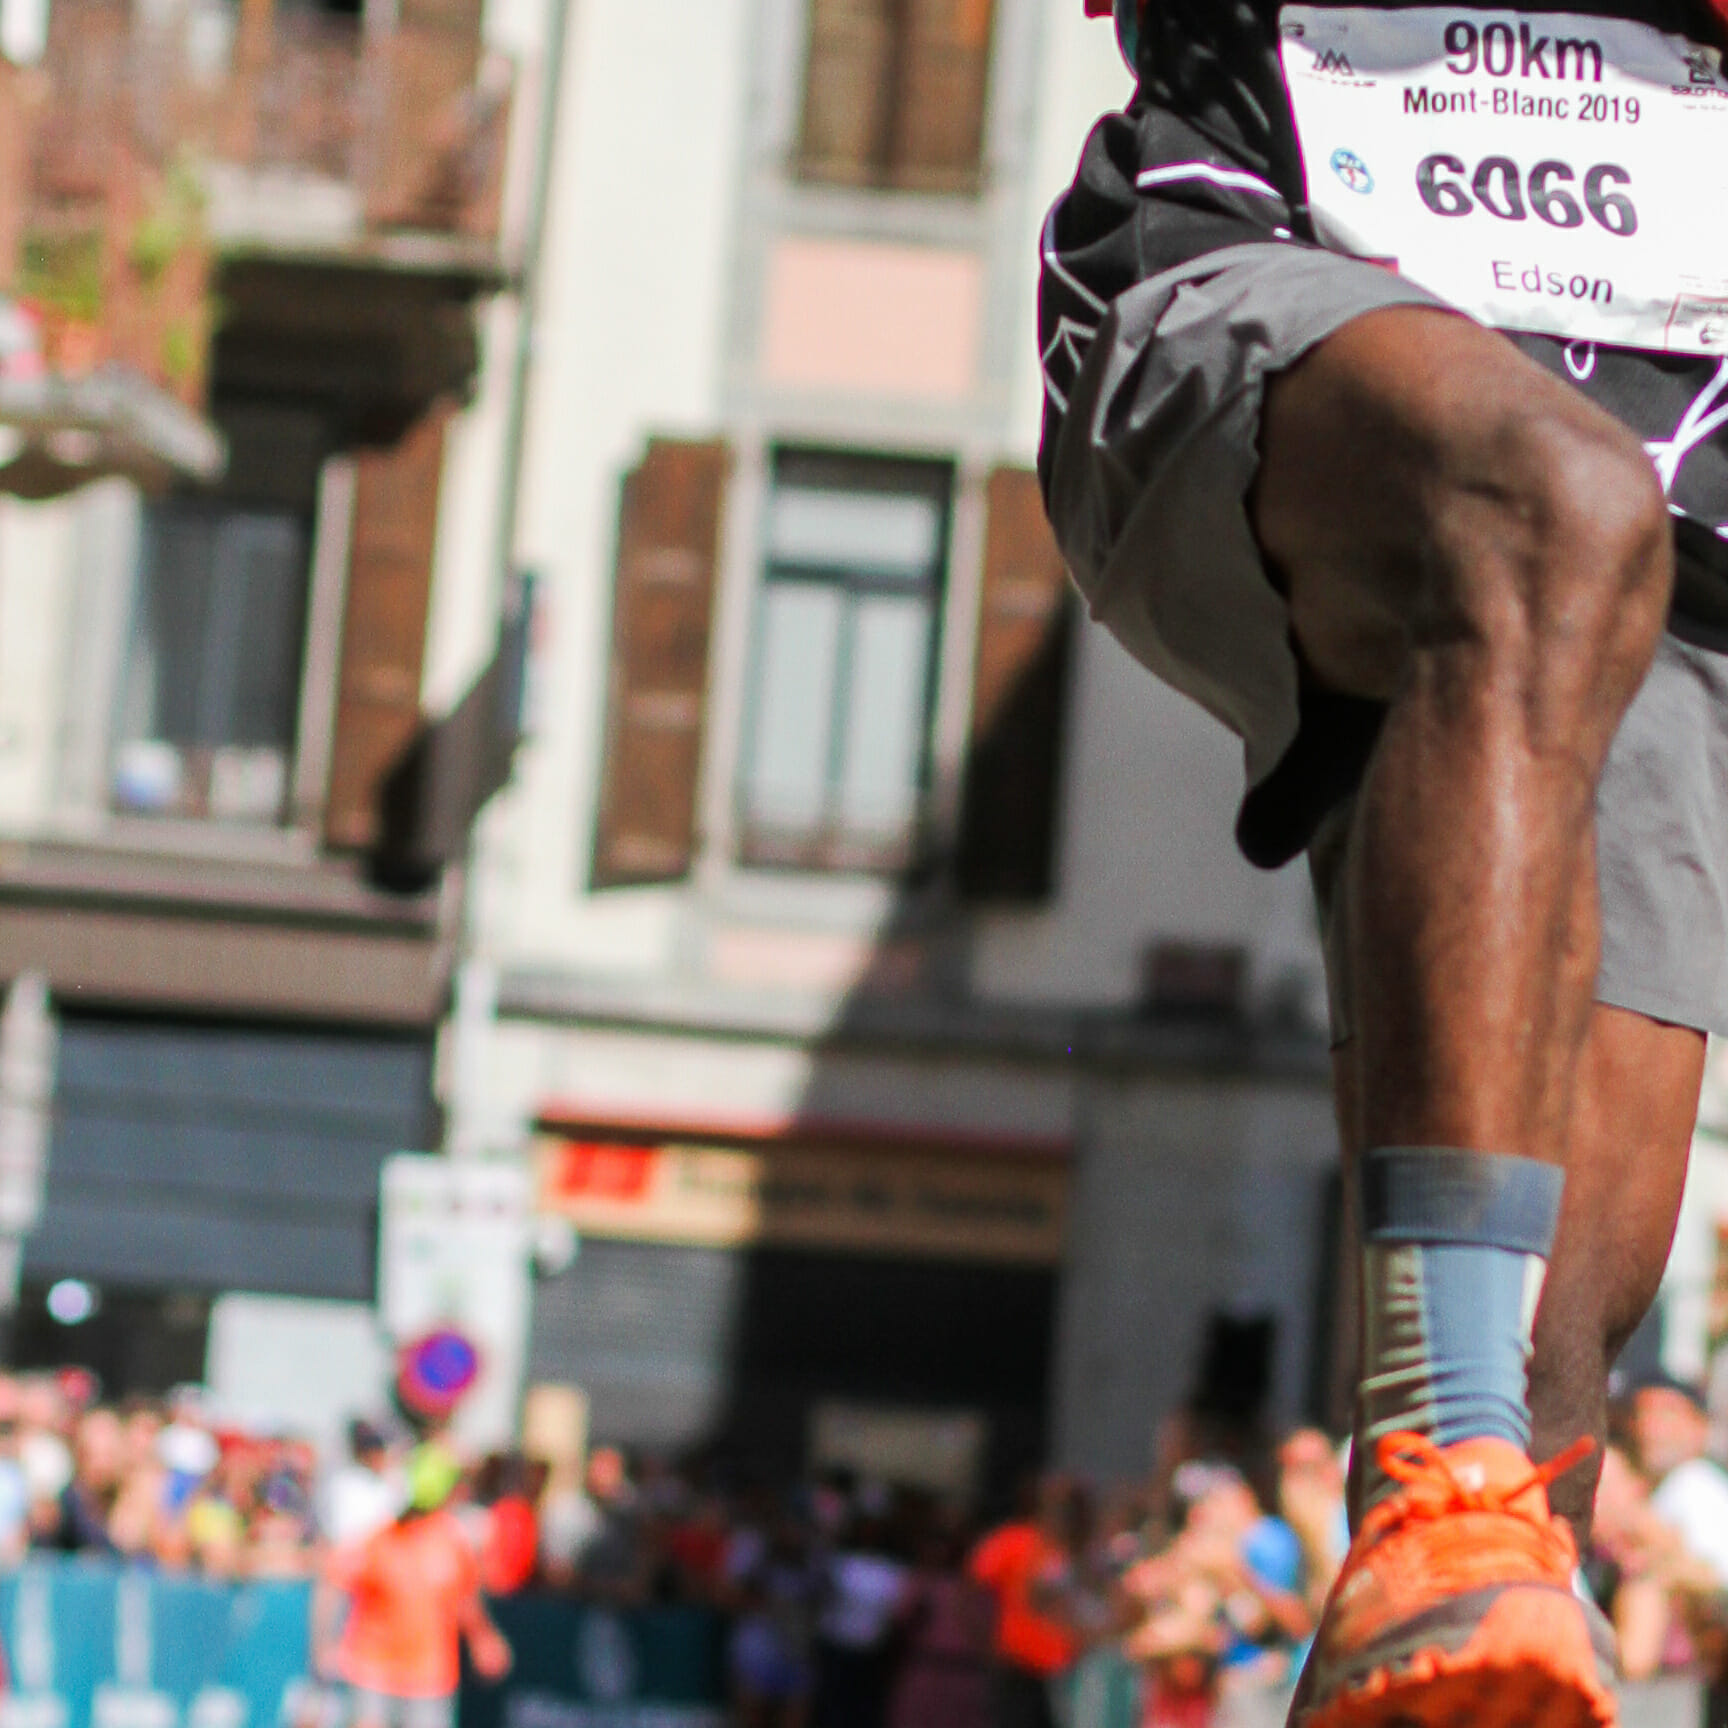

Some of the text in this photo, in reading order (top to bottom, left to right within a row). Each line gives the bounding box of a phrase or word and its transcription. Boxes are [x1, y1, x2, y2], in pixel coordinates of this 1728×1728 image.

[1443, 20, 1603, 83] 90km
[1402, 87, 1641, 124] Mont-Blanc 2019
[1415, 153, 1639, 237] 6066
[1491, 260, 1614, 304] Edson
